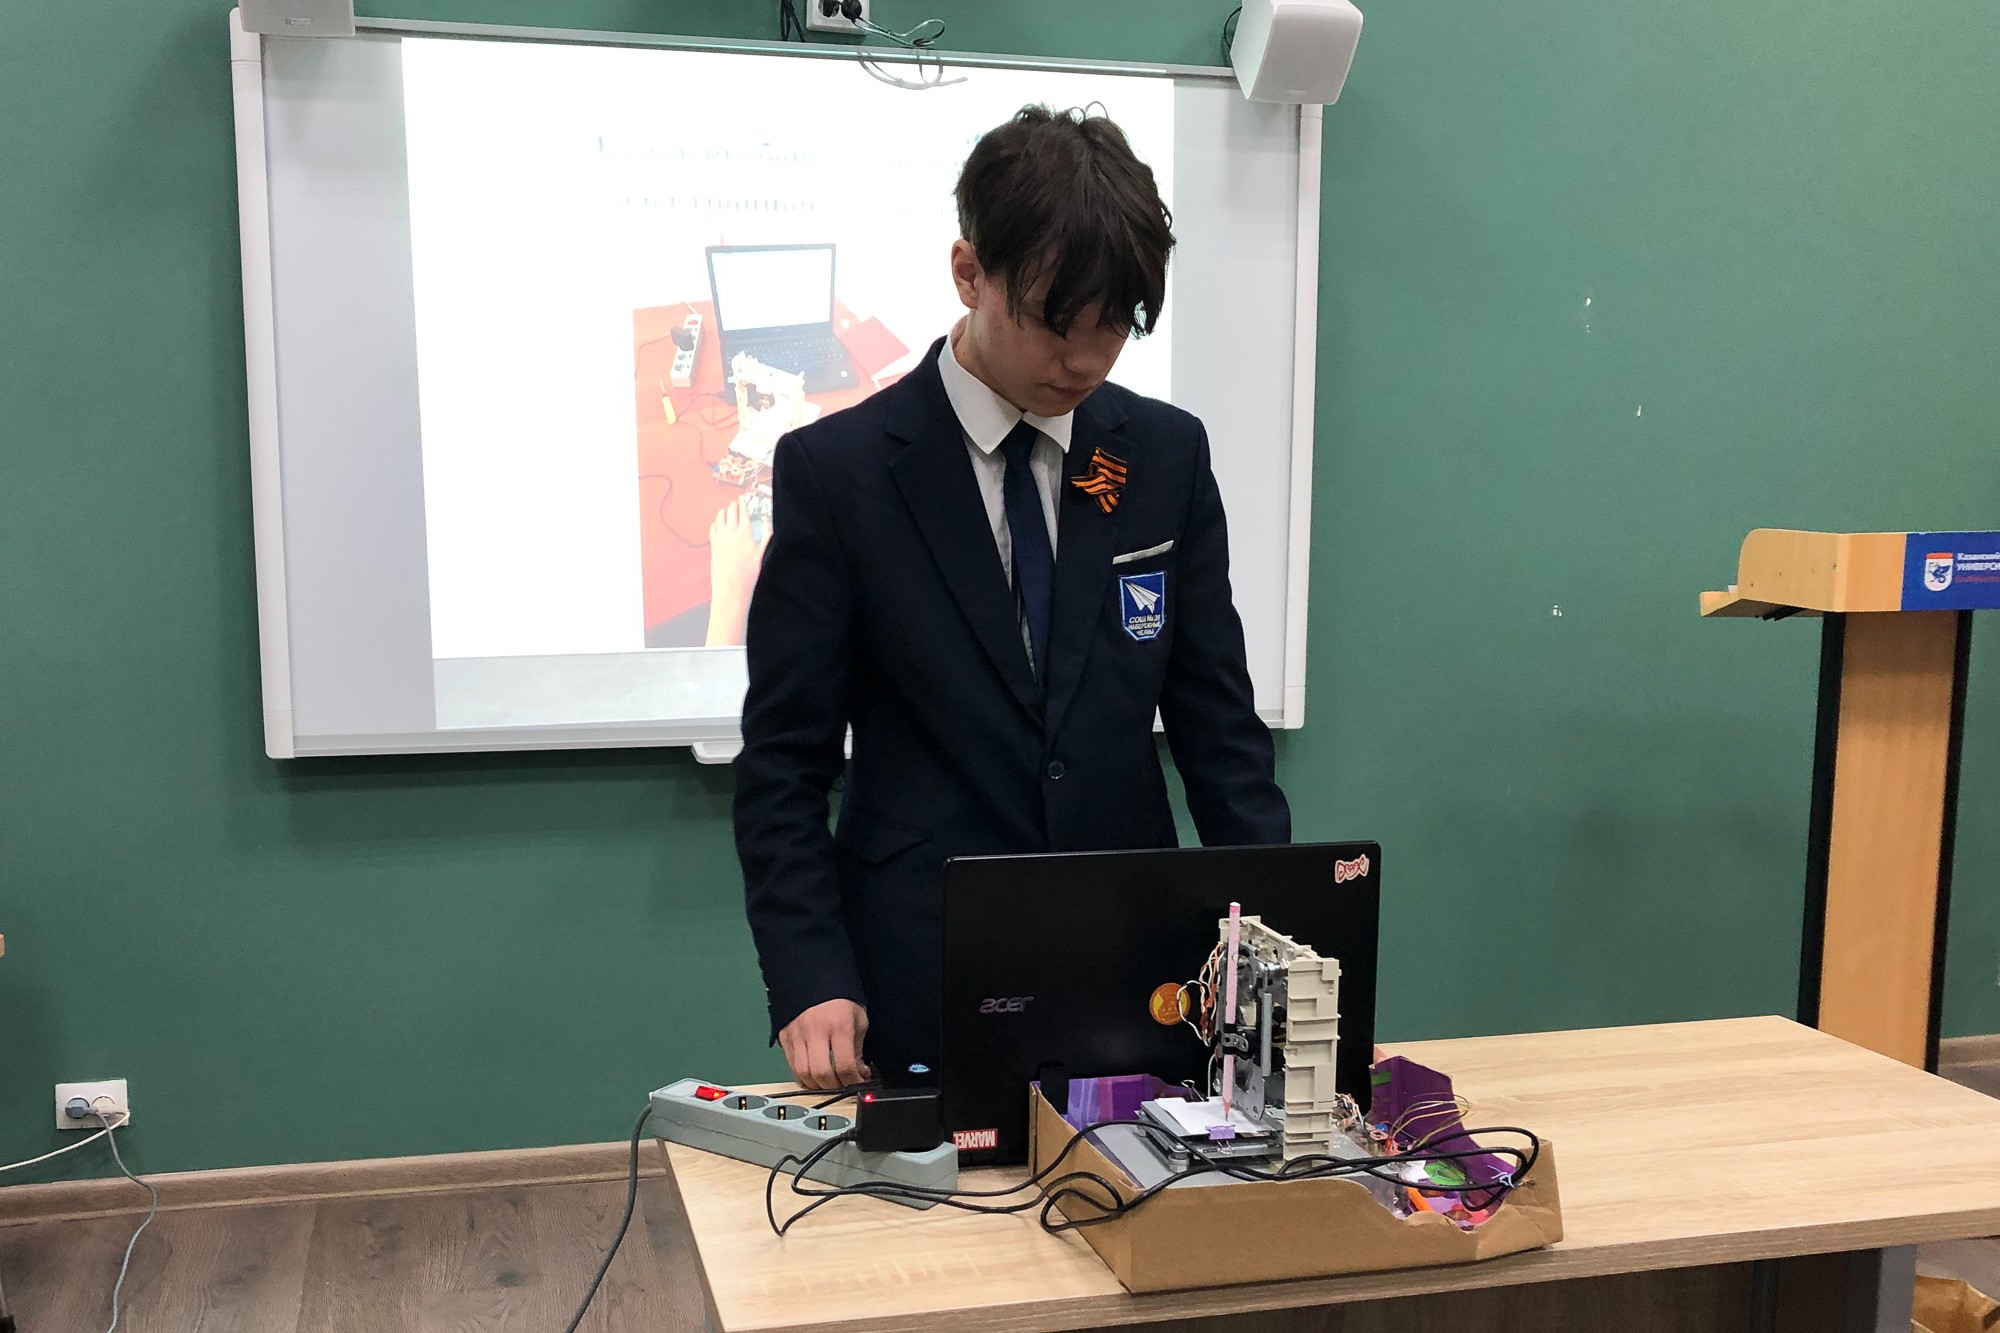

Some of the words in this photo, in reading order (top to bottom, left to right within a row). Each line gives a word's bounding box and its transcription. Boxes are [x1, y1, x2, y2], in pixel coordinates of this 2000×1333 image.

[1129, 616, 1146, 624] СОШ
[979, 996, 1034, 1014] acer
[953, 1130, 996, 1149] MARVEL
